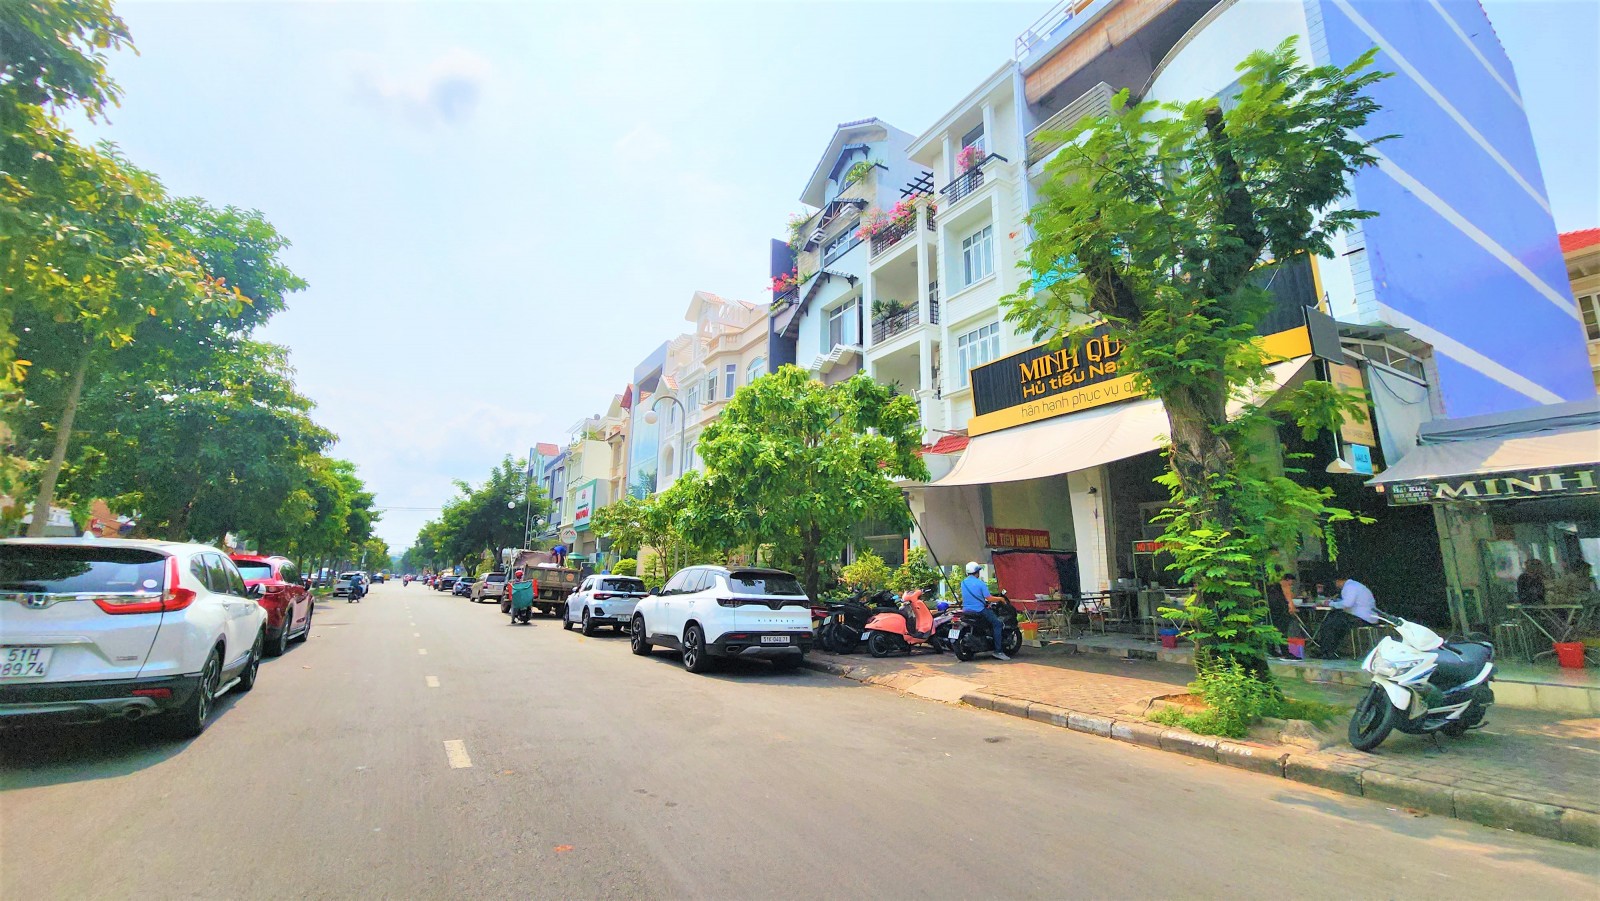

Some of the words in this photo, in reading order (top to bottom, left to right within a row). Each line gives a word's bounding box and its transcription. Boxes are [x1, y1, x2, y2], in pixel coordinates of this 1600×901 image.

[1019, 347, 1080, 384] MINH
[1023, 380, 1046, 398] Hủ
[1049, 367, 1085, 390] tiếu
[1021, 404, 1040, 418] hân
[1042, 395, 1069, 413] hạnh
[1072, 389, 1101, 409] phục
[1103, 383, 1119, 398] vụ
[1435, 470, 1598, 498] MINH
[7, 648, 41, 662] 51H
